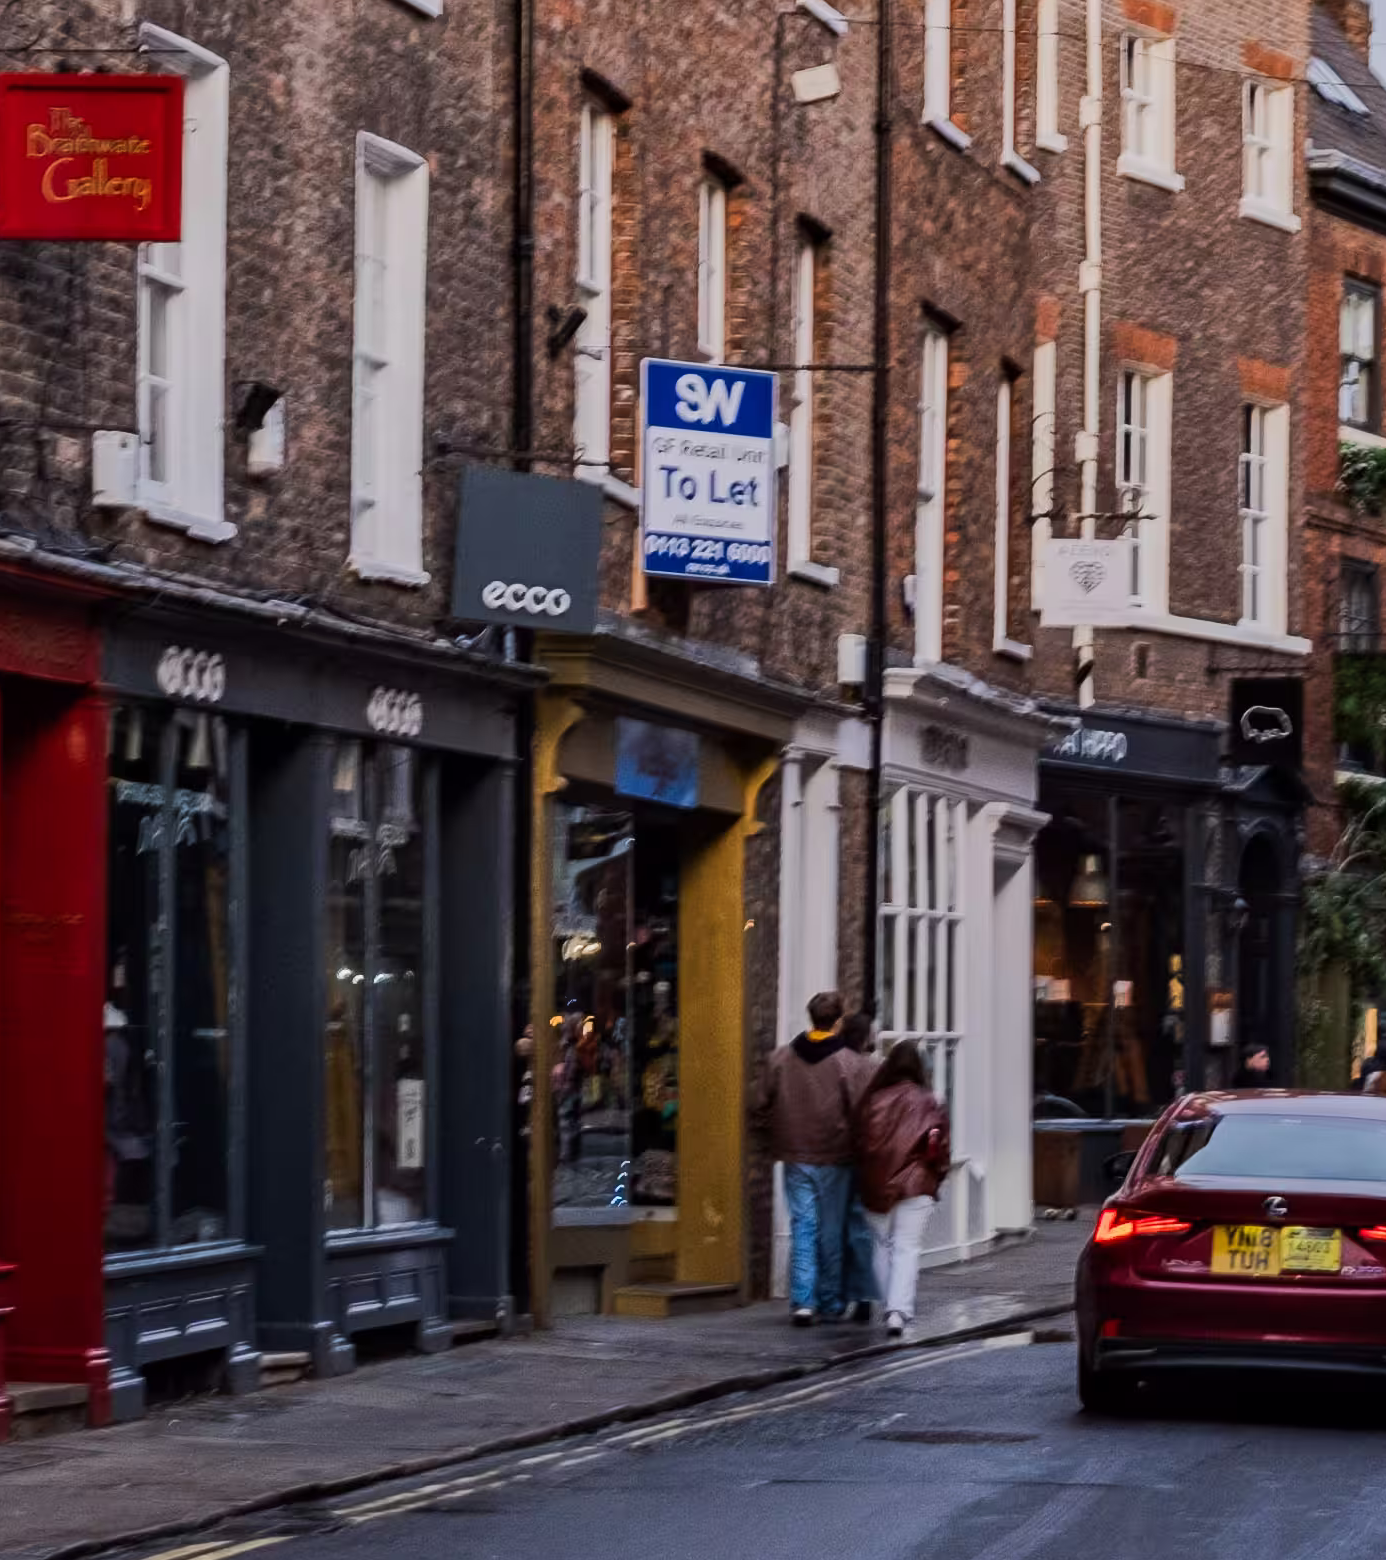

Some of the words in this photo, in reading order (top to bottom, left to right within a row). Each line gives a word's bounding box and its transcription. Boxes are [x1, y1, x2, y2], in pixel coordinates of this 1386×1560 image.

[41, 157, 152, 213] Gallery
[674, 373, 747, 427] SW
[659, 465, 697, 501] To
[709, 468, 758, 507] Let
[481, 580, 571, 616] ecco
[1227, 1249, 1269, 1271] TUH
